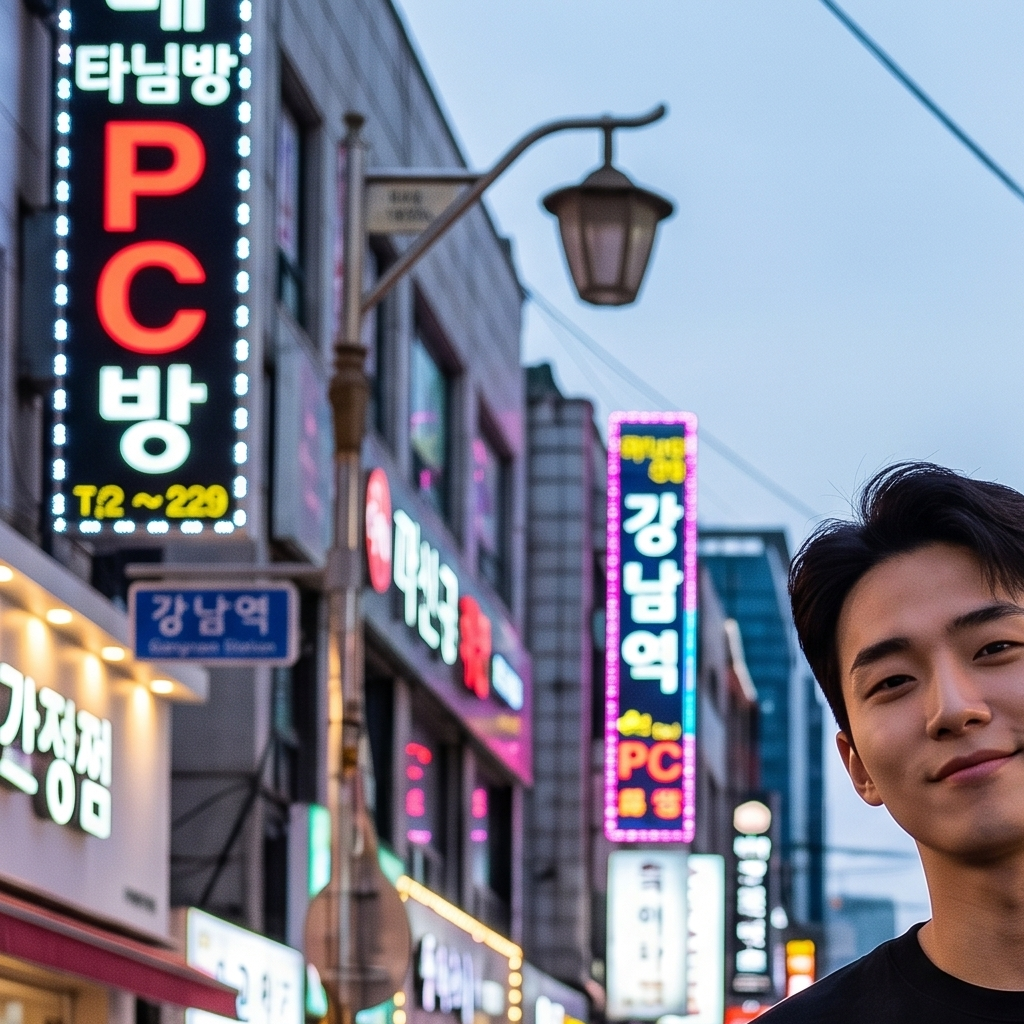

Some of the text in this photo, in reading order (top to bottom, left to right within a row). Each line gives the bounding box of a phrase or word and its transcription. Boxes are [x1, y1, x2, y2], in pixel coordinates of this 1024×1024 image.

[75, 42, 238, 106] 타님방
[151, 594, 270, 638] 강남역
[622, 490, 685, 695] 강남역
[618, 740, 684, 784] PC
